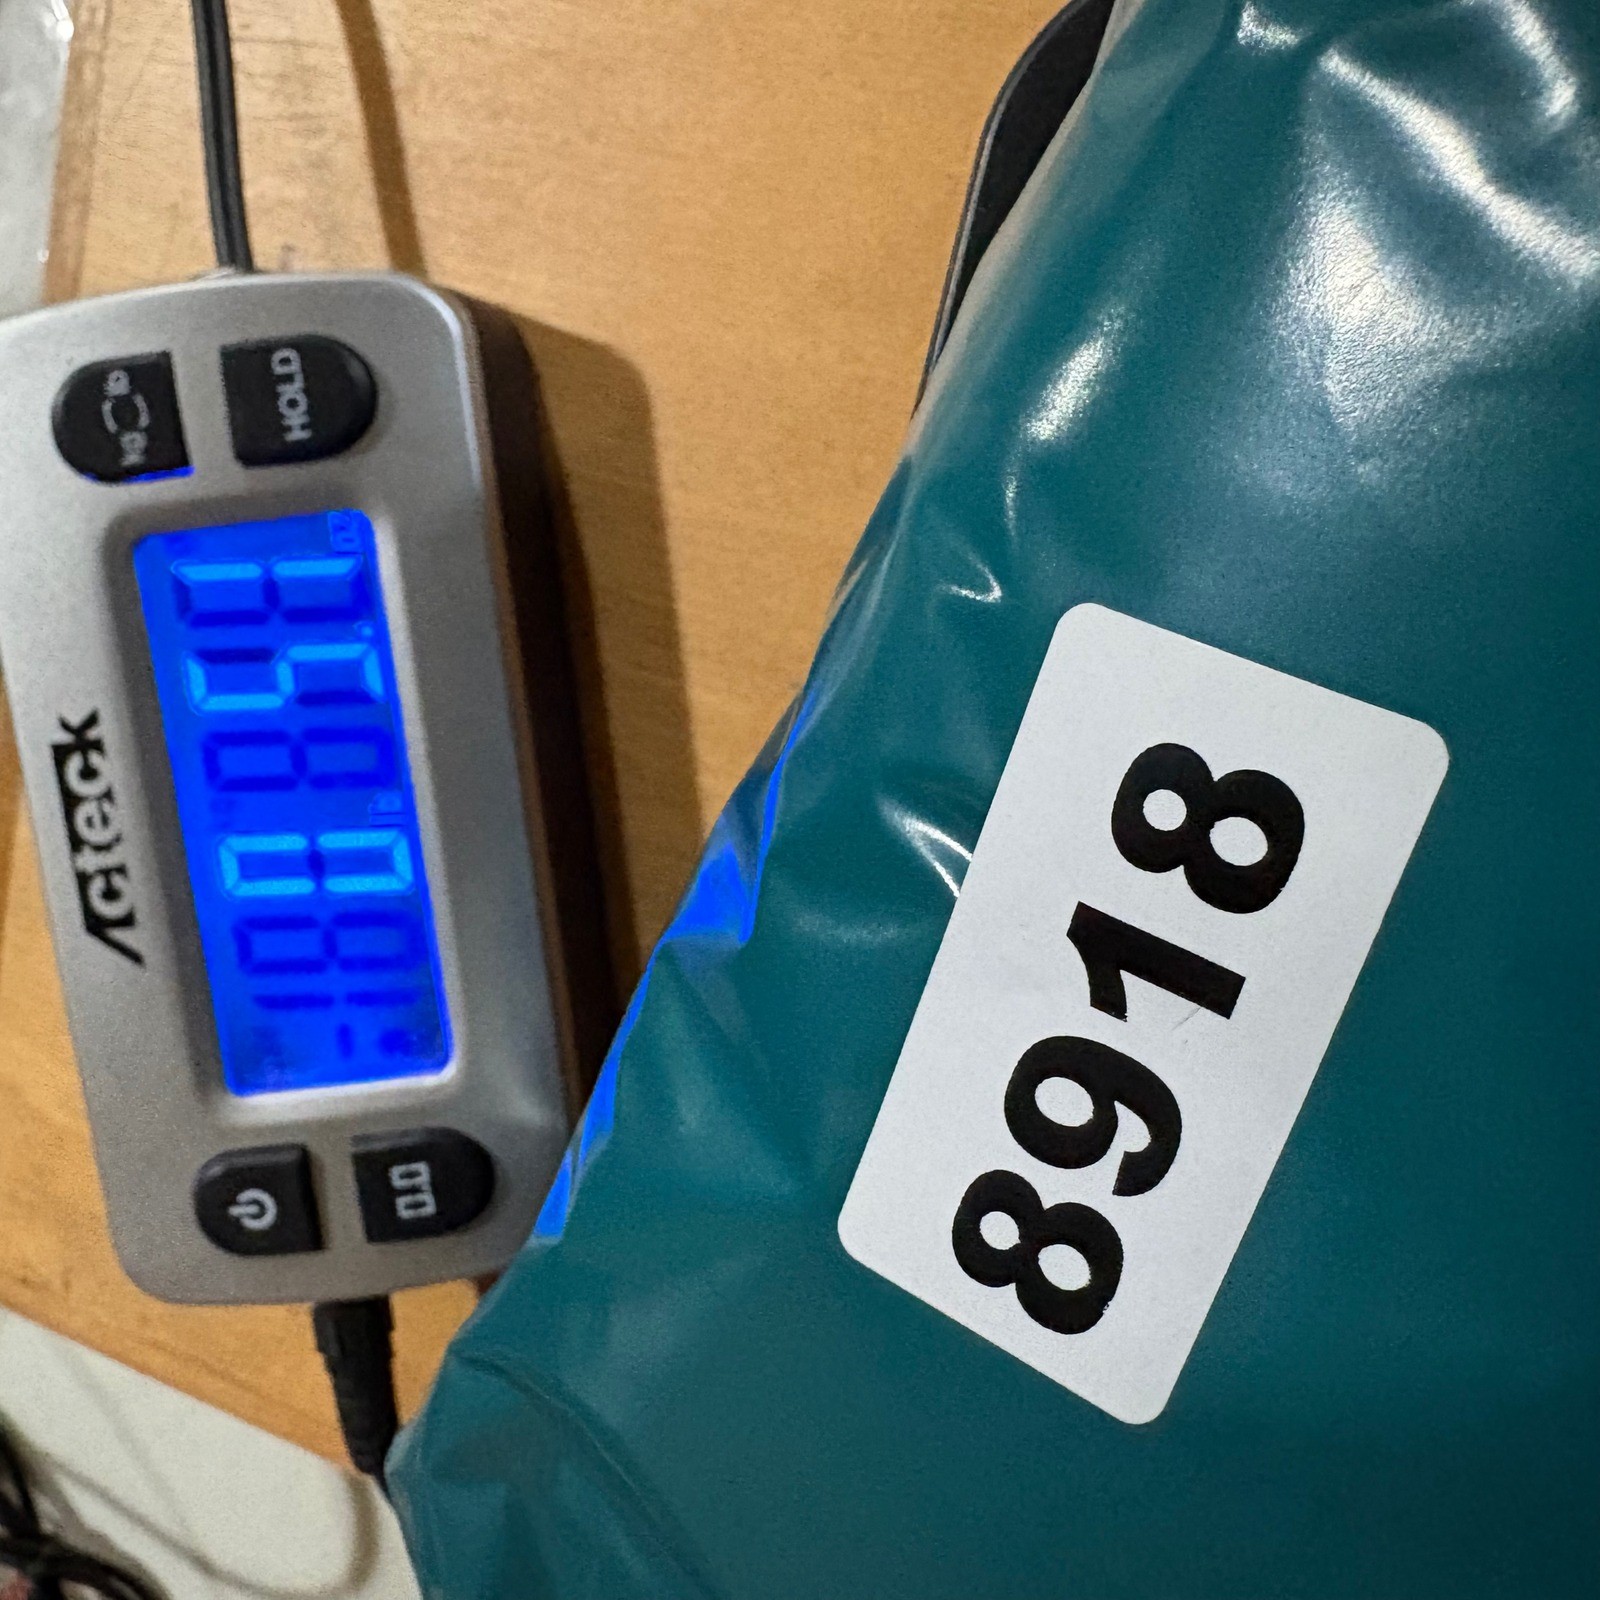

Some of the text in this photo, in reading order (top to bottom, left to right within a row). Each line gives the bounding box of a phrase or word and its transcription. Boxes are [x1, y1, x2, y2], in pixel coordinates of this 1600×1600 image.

[270, 347, 312, 442] HOLD
[51, 708, 145, 965] Acteck
[951, 742, 1306, 1335] 8918
